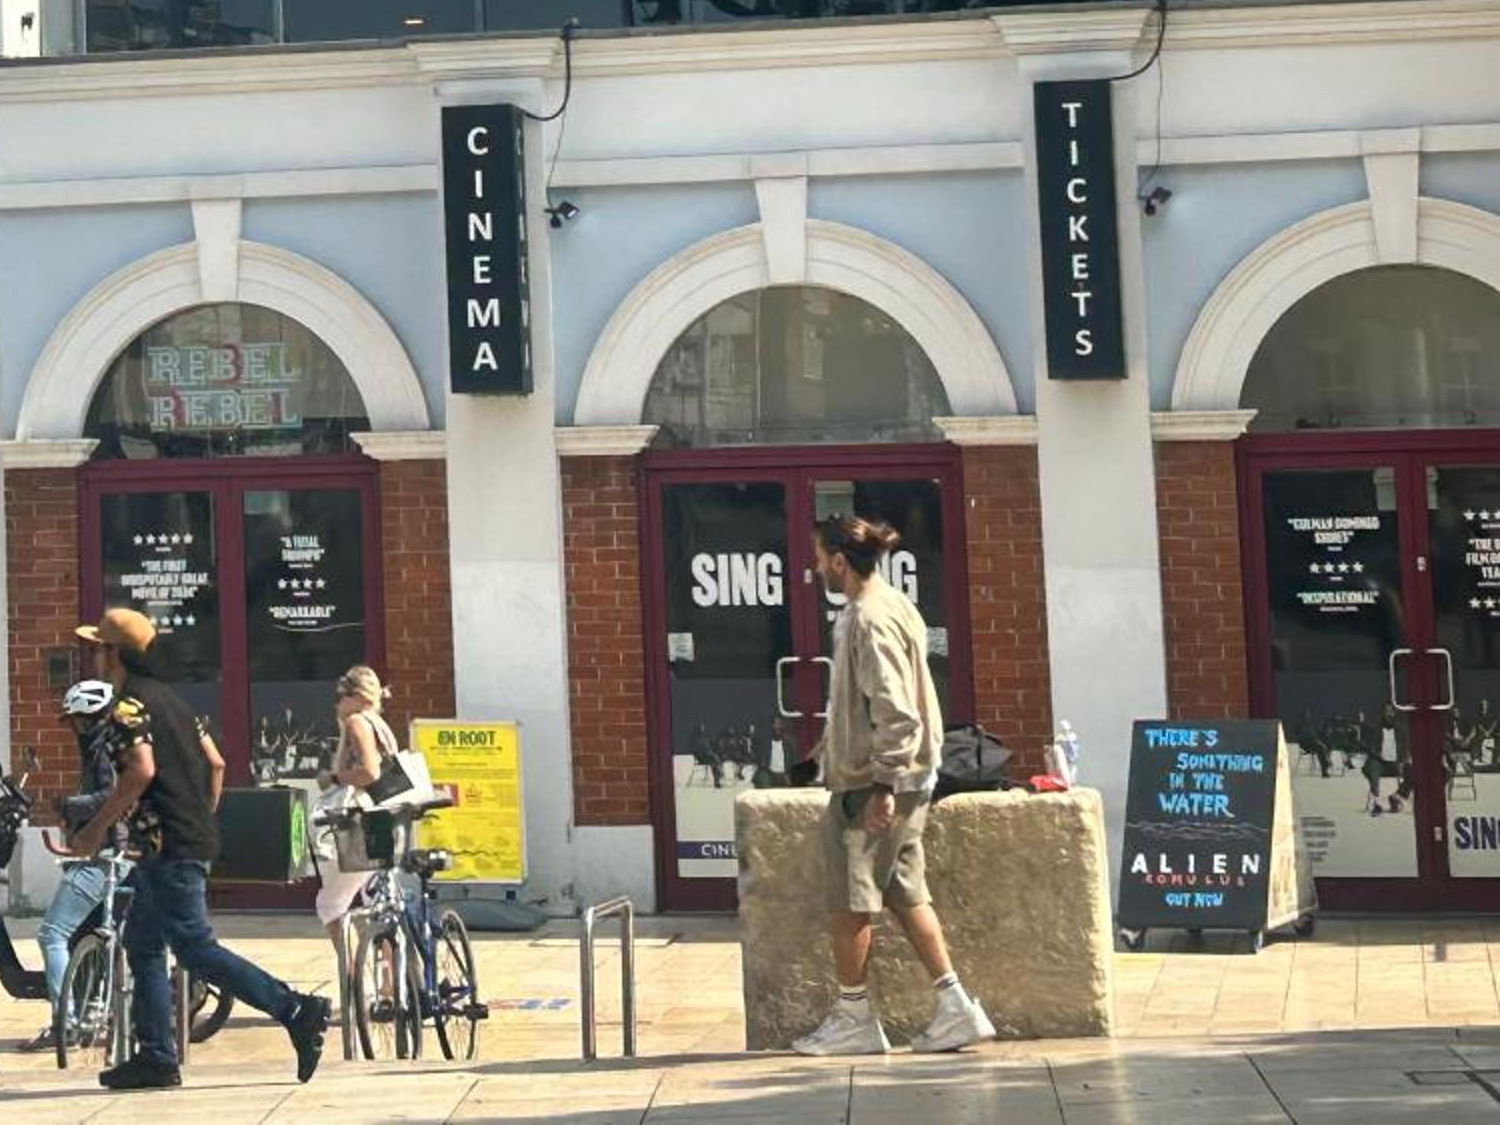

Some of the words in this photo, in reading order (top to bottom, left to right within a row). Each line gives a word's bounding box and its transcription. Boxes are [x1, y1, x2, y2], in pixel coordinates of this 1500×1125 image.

[1061, 102, 1094, 356] TICKETS
[466, 126, 501, 372] CINEMA
[691, 552, 783, 607] SING
[459, 730, 496, 746] ROOT
[1192, 772, 1225, 790] THE
[1158, 792, 1236, 818] WATER
[1454, 816, 1500, 850] SIN
[1130, 853, 1260, 874] ALIEN
